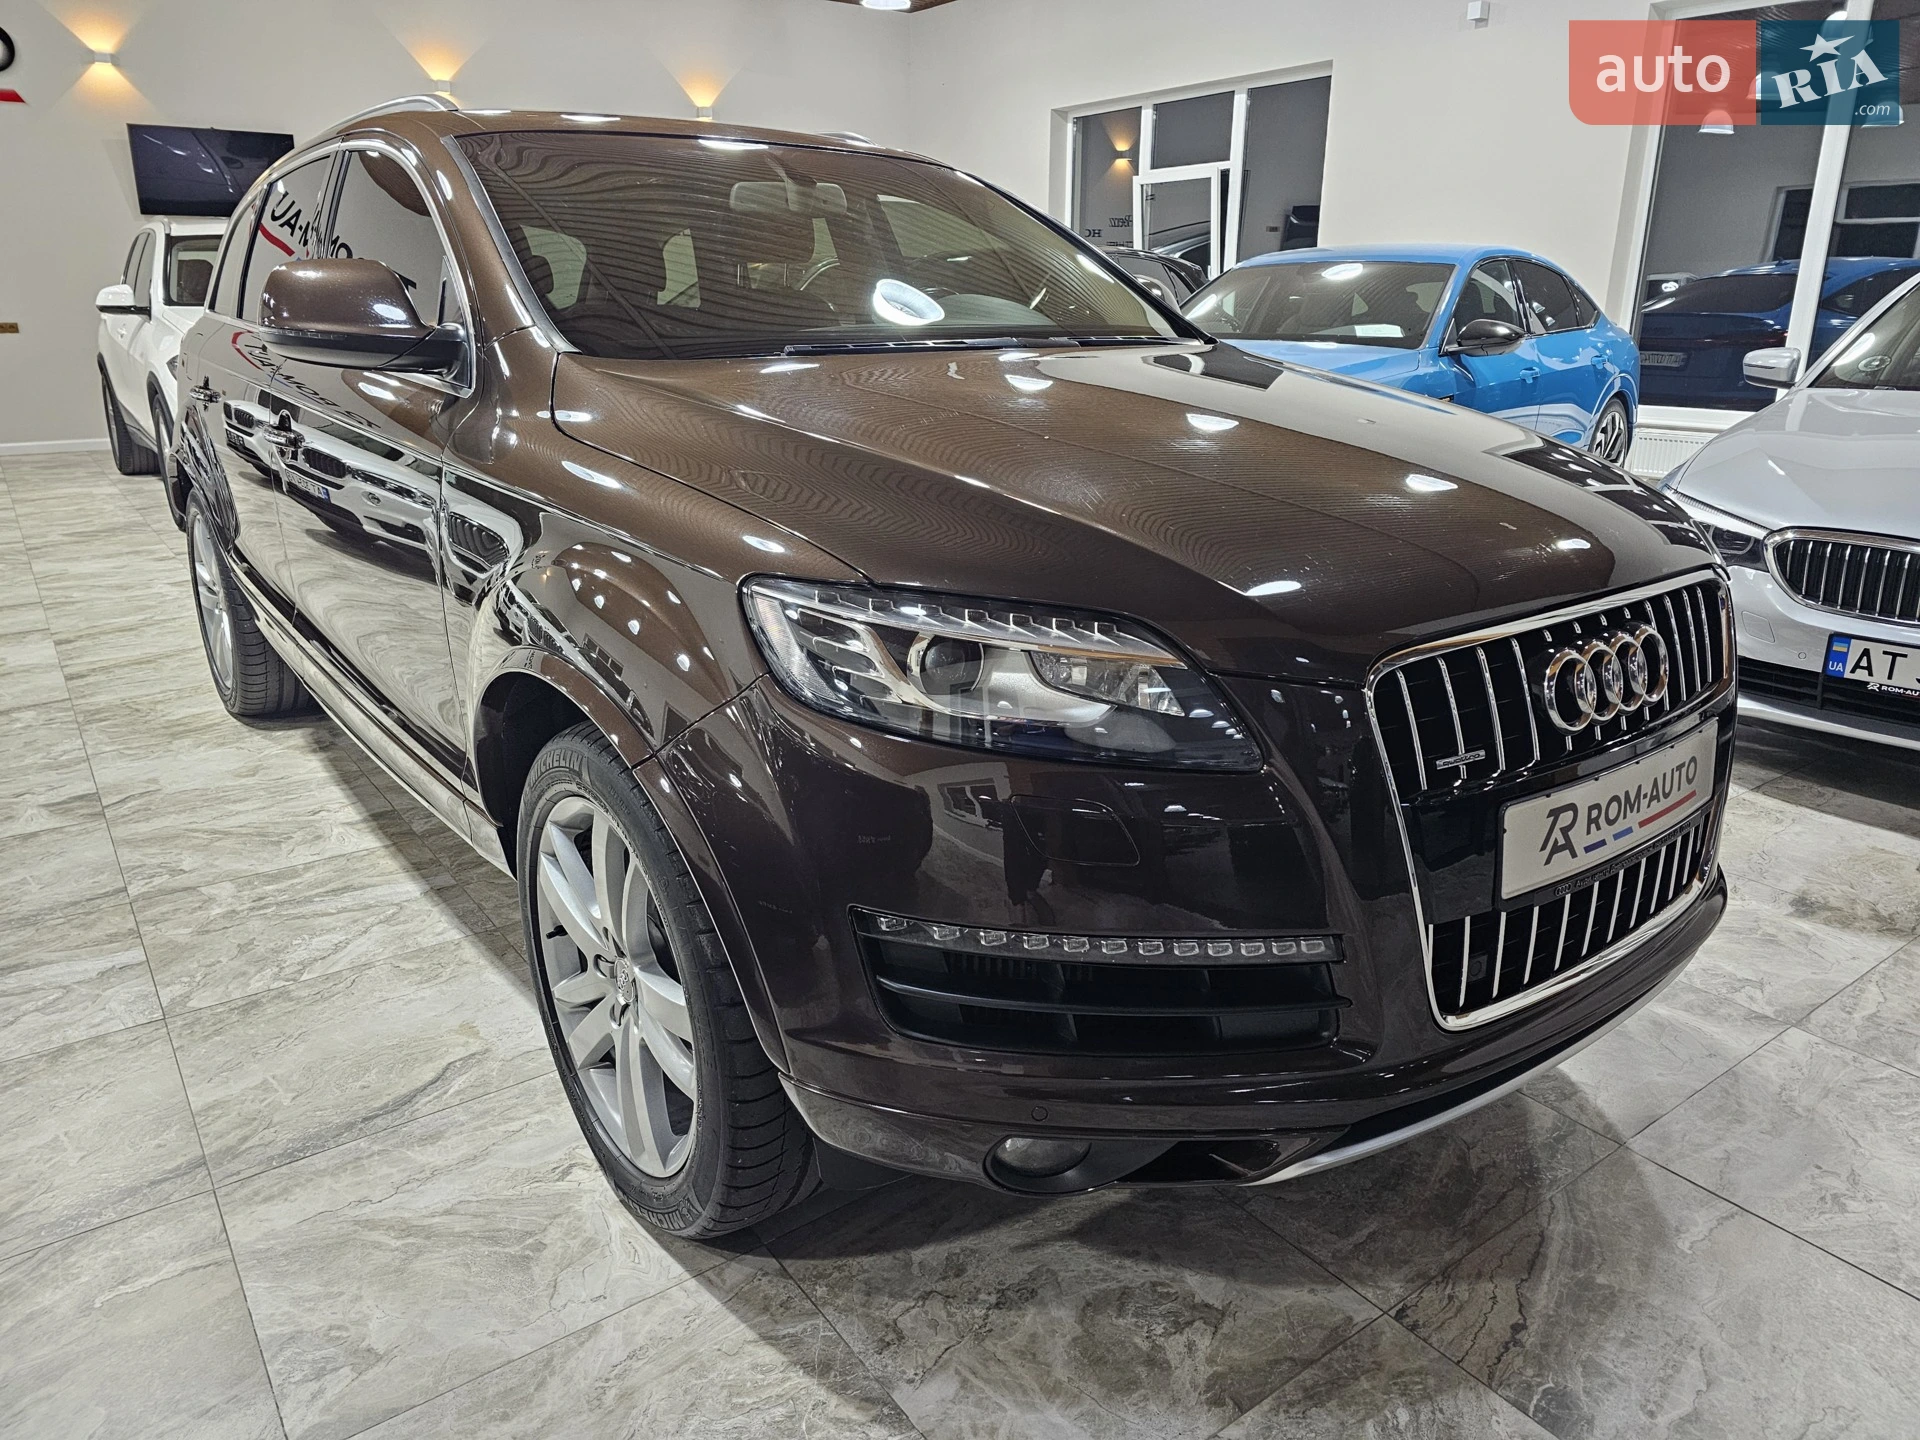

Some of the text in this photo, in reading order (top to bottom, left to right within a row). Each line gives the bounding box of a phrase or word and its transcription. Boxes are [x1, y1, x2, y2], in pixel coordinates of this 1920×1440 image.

[1828, 647, 1909, 680] UA AT
[1881, 685, 1920, 696] ROM-AU
[528, 748, 584, 786] MICHELIN
[1586, 755, 1698, 836] ROM-AUTO
